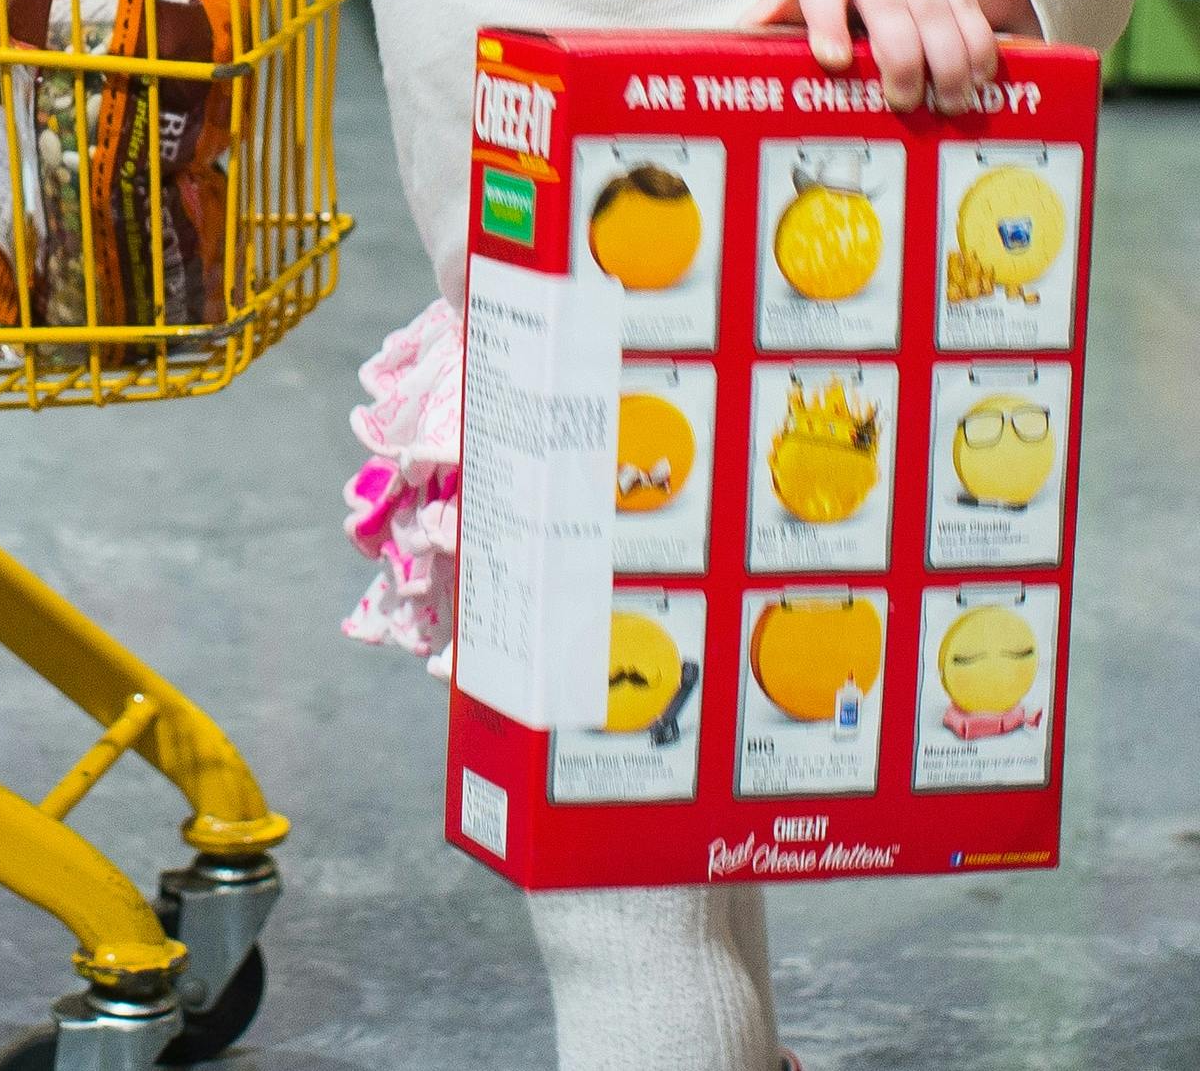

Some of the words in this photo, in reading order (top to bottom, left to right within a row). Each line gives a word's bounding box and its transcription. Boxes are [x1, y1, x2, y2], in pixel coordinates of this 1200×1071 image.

[623, 74, 687, 111] ARE
[692, 75, 785, 113] THESE
[791, 77, 894, 113] CHEES
[926, 80, 1042, 115] ADY?
[708, 831, 755, 882] Real
[753, 842, 817, 875] Cheese
